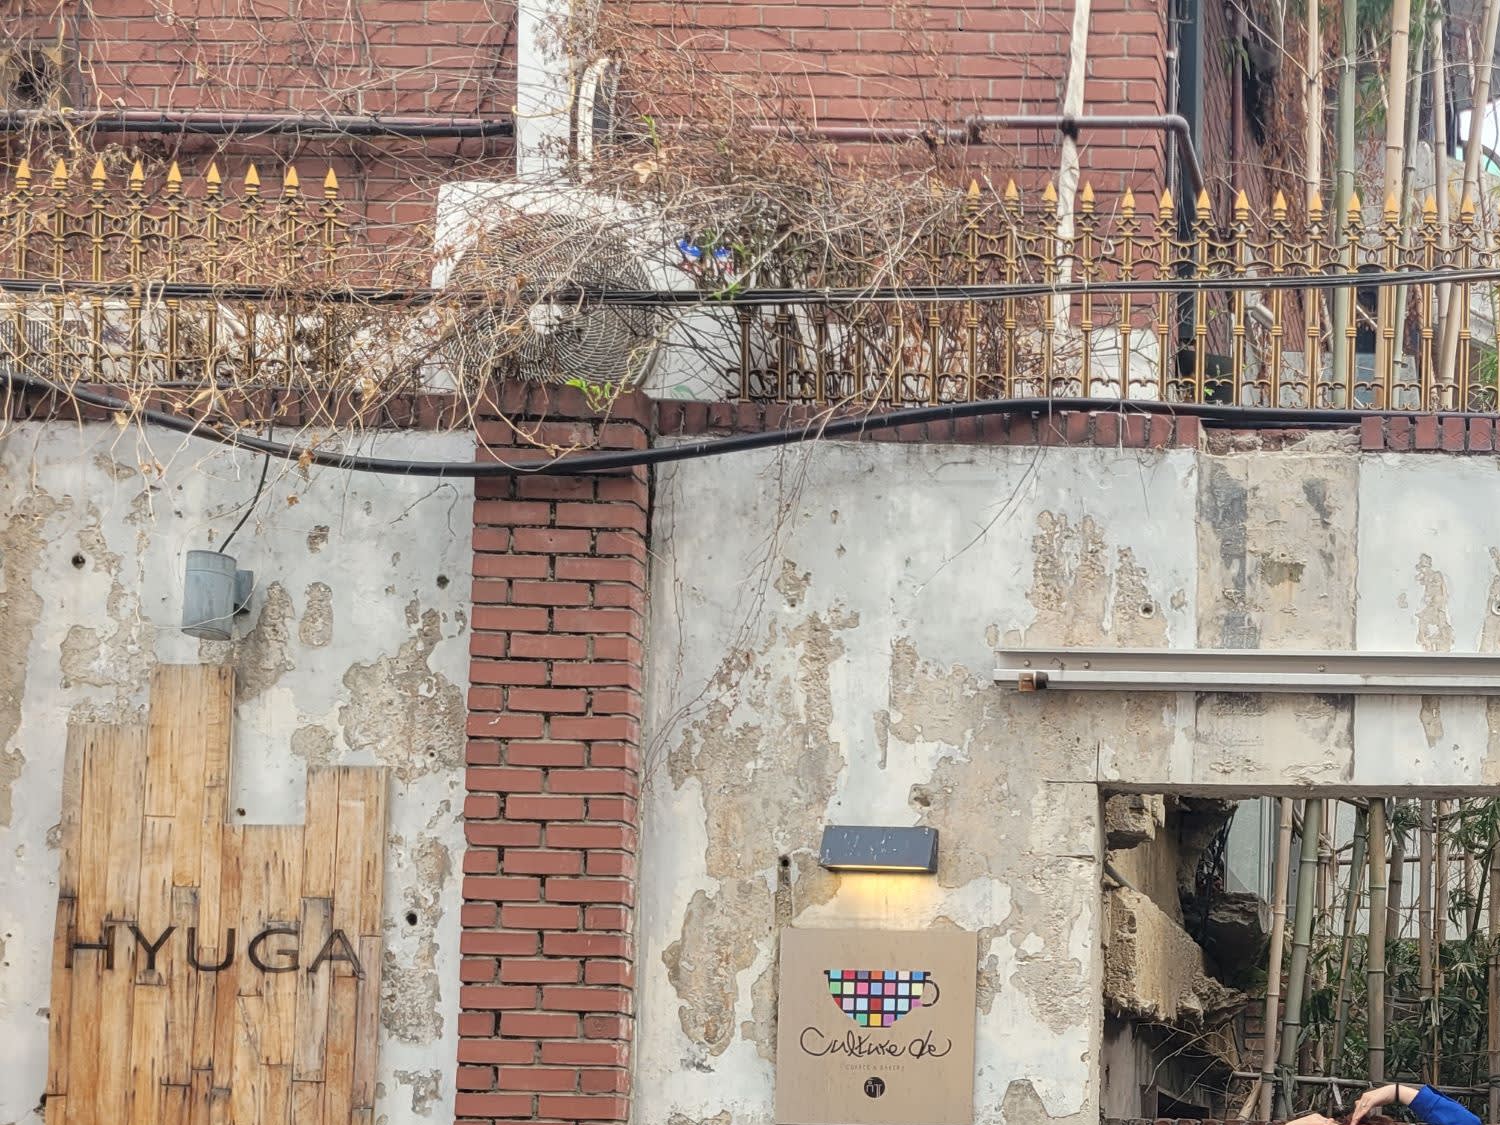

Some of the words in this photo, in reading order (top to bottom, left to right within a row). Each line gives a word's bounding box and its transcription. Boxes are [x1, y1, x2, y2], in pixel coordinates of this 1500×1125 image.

[65, 925, 365, 980] HYUGA
[800, 1026, 906, 1058] Culture
[908, 1029, 952, 1060] de
